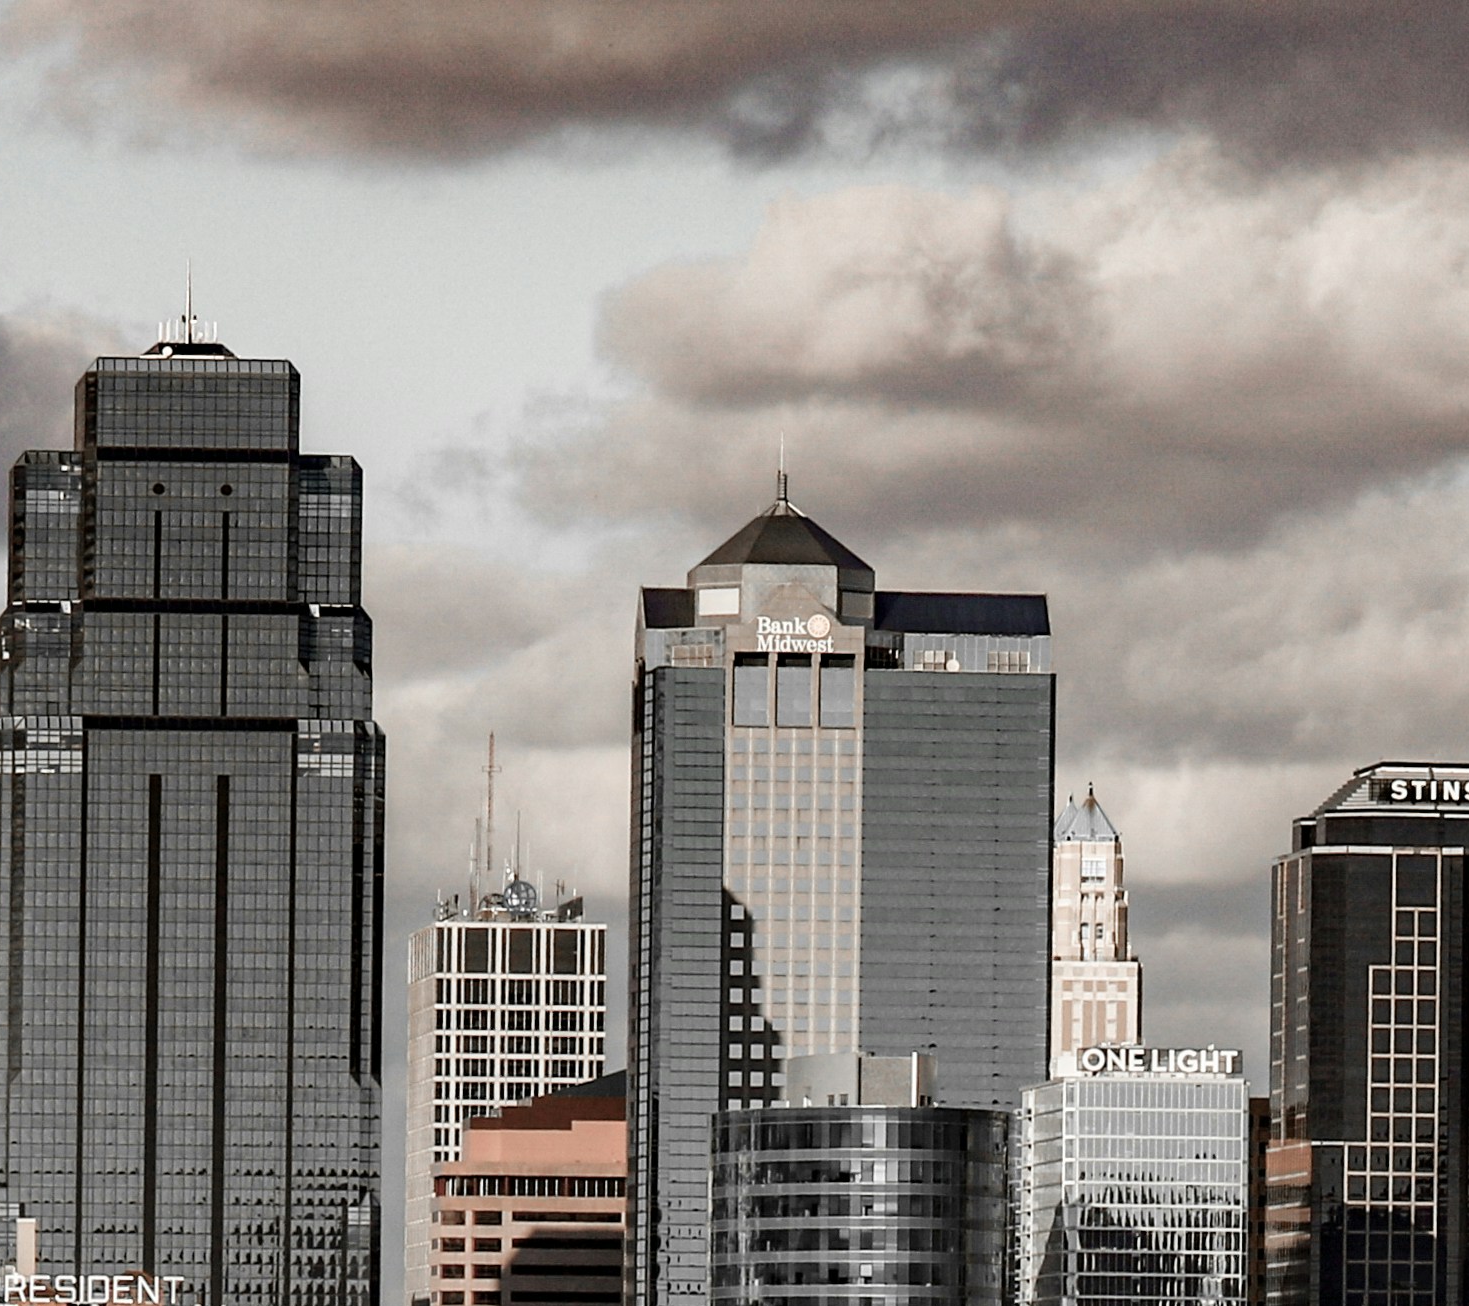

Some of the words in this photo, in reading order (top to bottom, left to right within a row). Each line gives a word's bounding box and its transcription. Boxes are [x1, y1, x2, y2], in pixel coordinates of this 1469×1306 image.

[756, 615, 807, 634] Bank
[756, 634, 834, 652] Midwest
[1082, 1047, 1145, 1072] ONE
[1151, 1049, 1239, 1074] LIGHT
